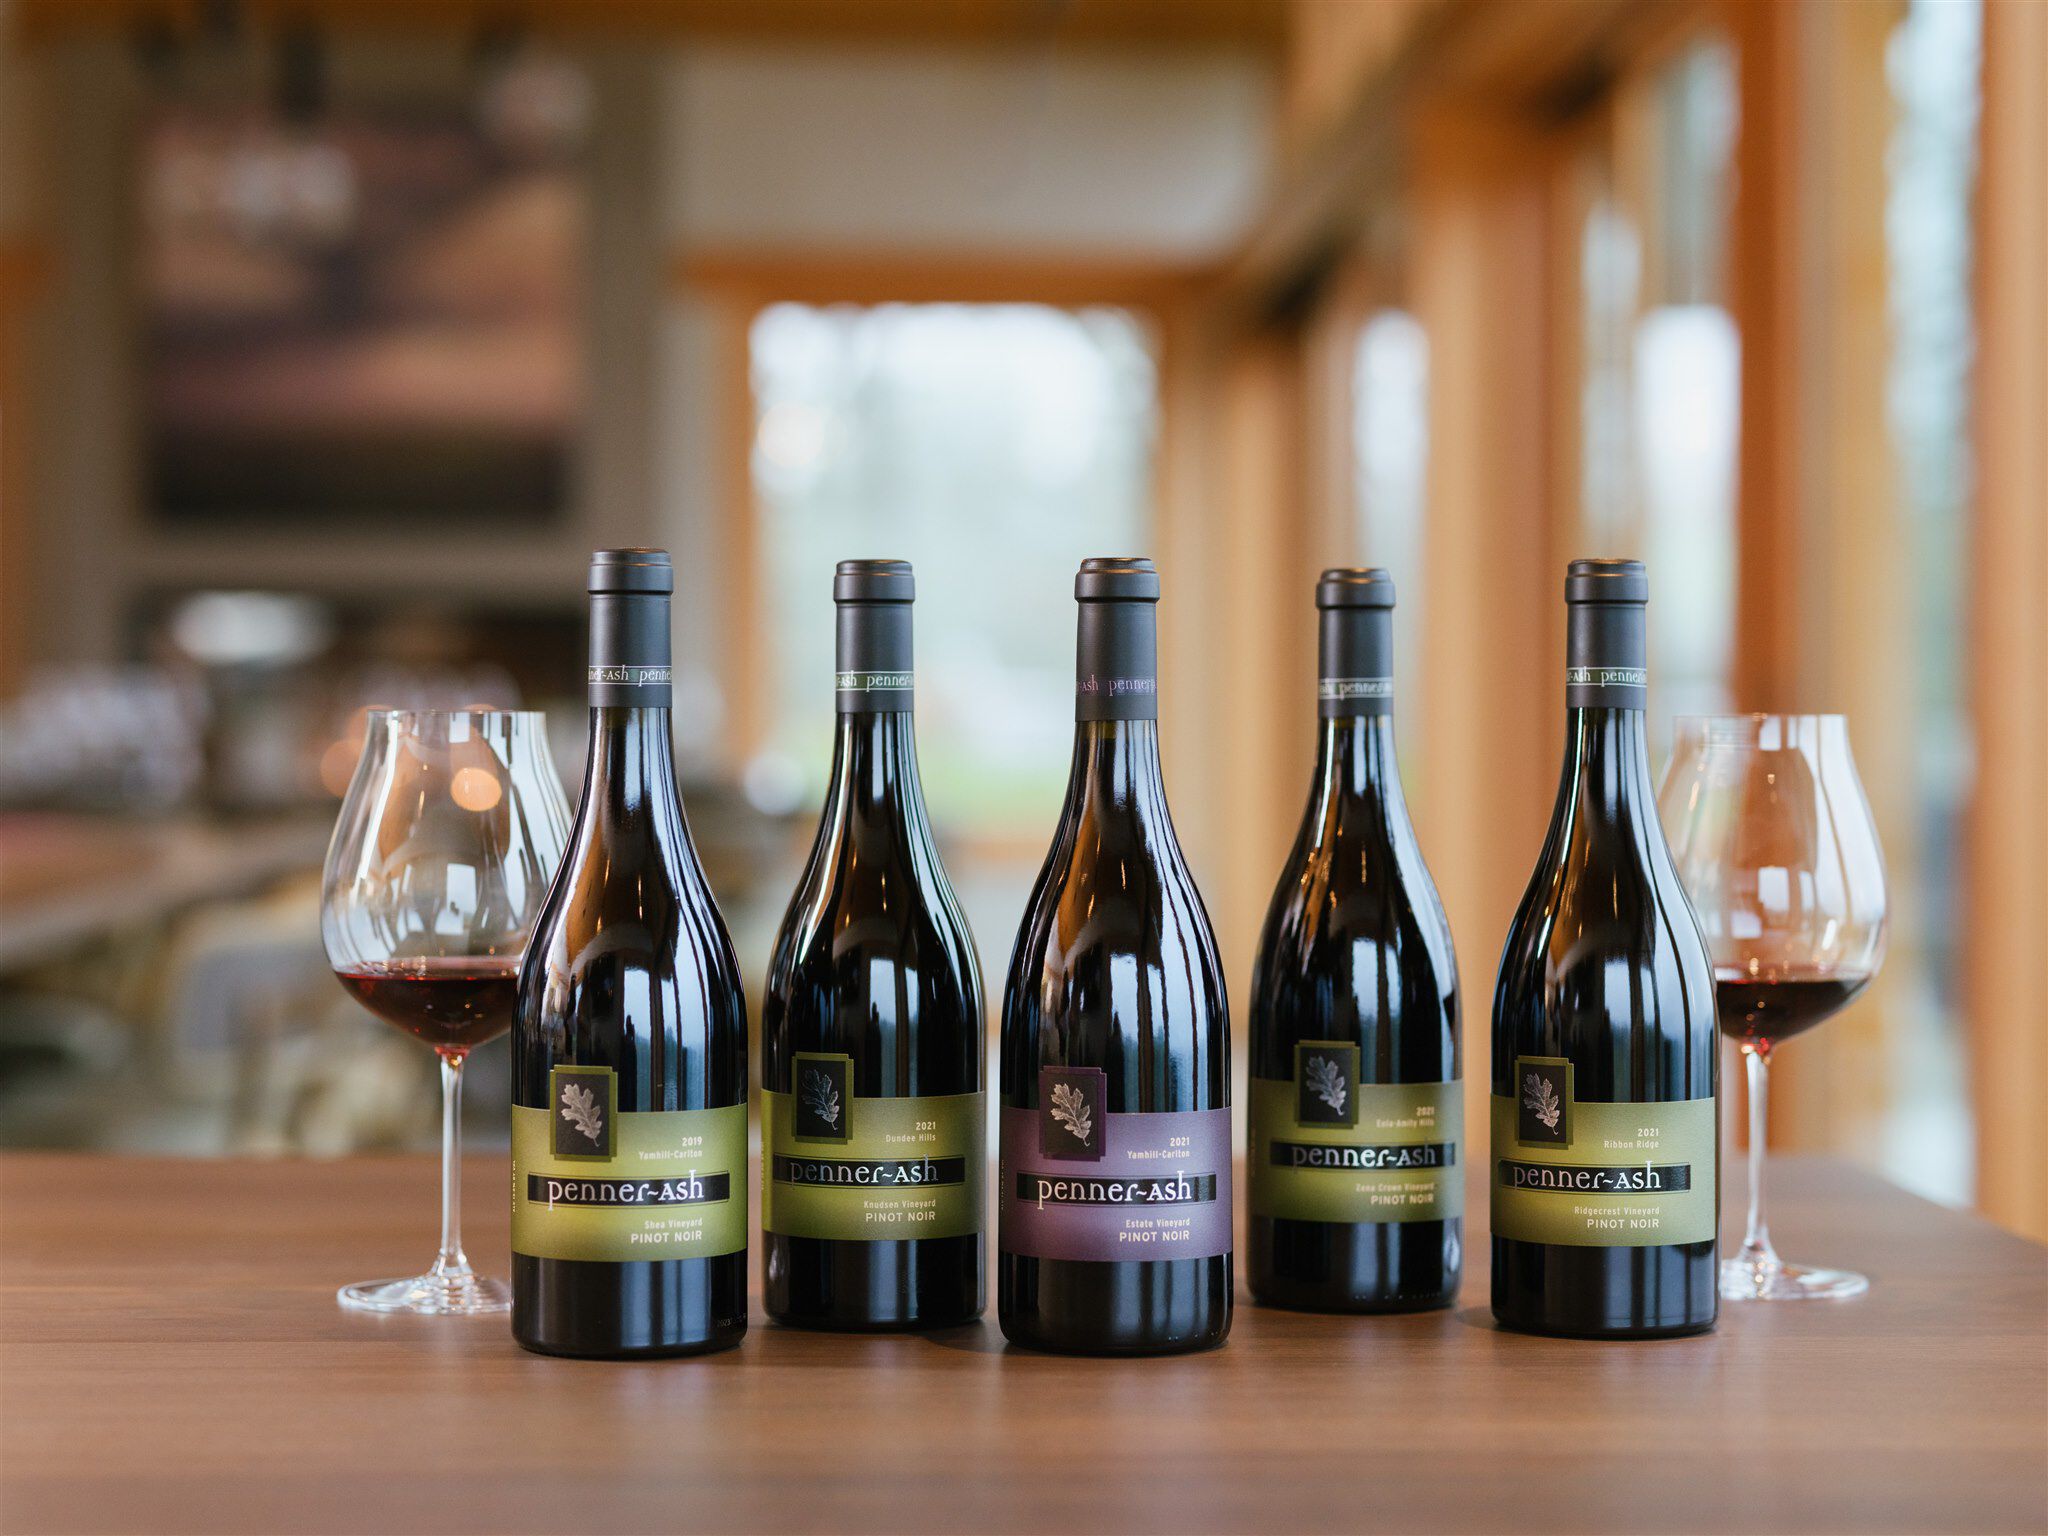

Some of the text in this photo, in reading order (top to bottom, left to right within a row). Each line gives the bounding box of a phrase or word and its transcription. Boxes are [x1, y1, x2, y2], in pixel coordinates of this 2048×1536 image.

[915, 1121, 937, 1131] 2021
[885, 1133, 936, 1143] Dundee Hills
[1637, 1128, 1660, 1137] 2021
[681, 1136, 703, 1147] 2019
[1169, 1136, 1190, 1147] 2021
[1603, 1139, 1660, 1149] Ribbon Ridge
[638, 1150, 703, 1161] Yamhill-Carlton
[1127, 1150, 1190, 1160] Yamhill-Carlton
[863, 1199, 936, 1209] Knudsen Vineyard
[1370, 1193, 1434, 1205] PINOT NOIR
[865, 1211, 936, 1223] PINOT NOIR
[1574, 1206, 1660, 1217] Ridgecrest Vineyard
[644, 1218, 703, 1230] Shea Vineyard
[1125, 1218, 1191, 1229] Estate Vineyard
[1587, 1218, 1660, 1229] PINOT NOIR
[630, 1230, 703, 1244] PINOT NOIR
[1119, 1230, 1190, 1243] PINOT NOIR
